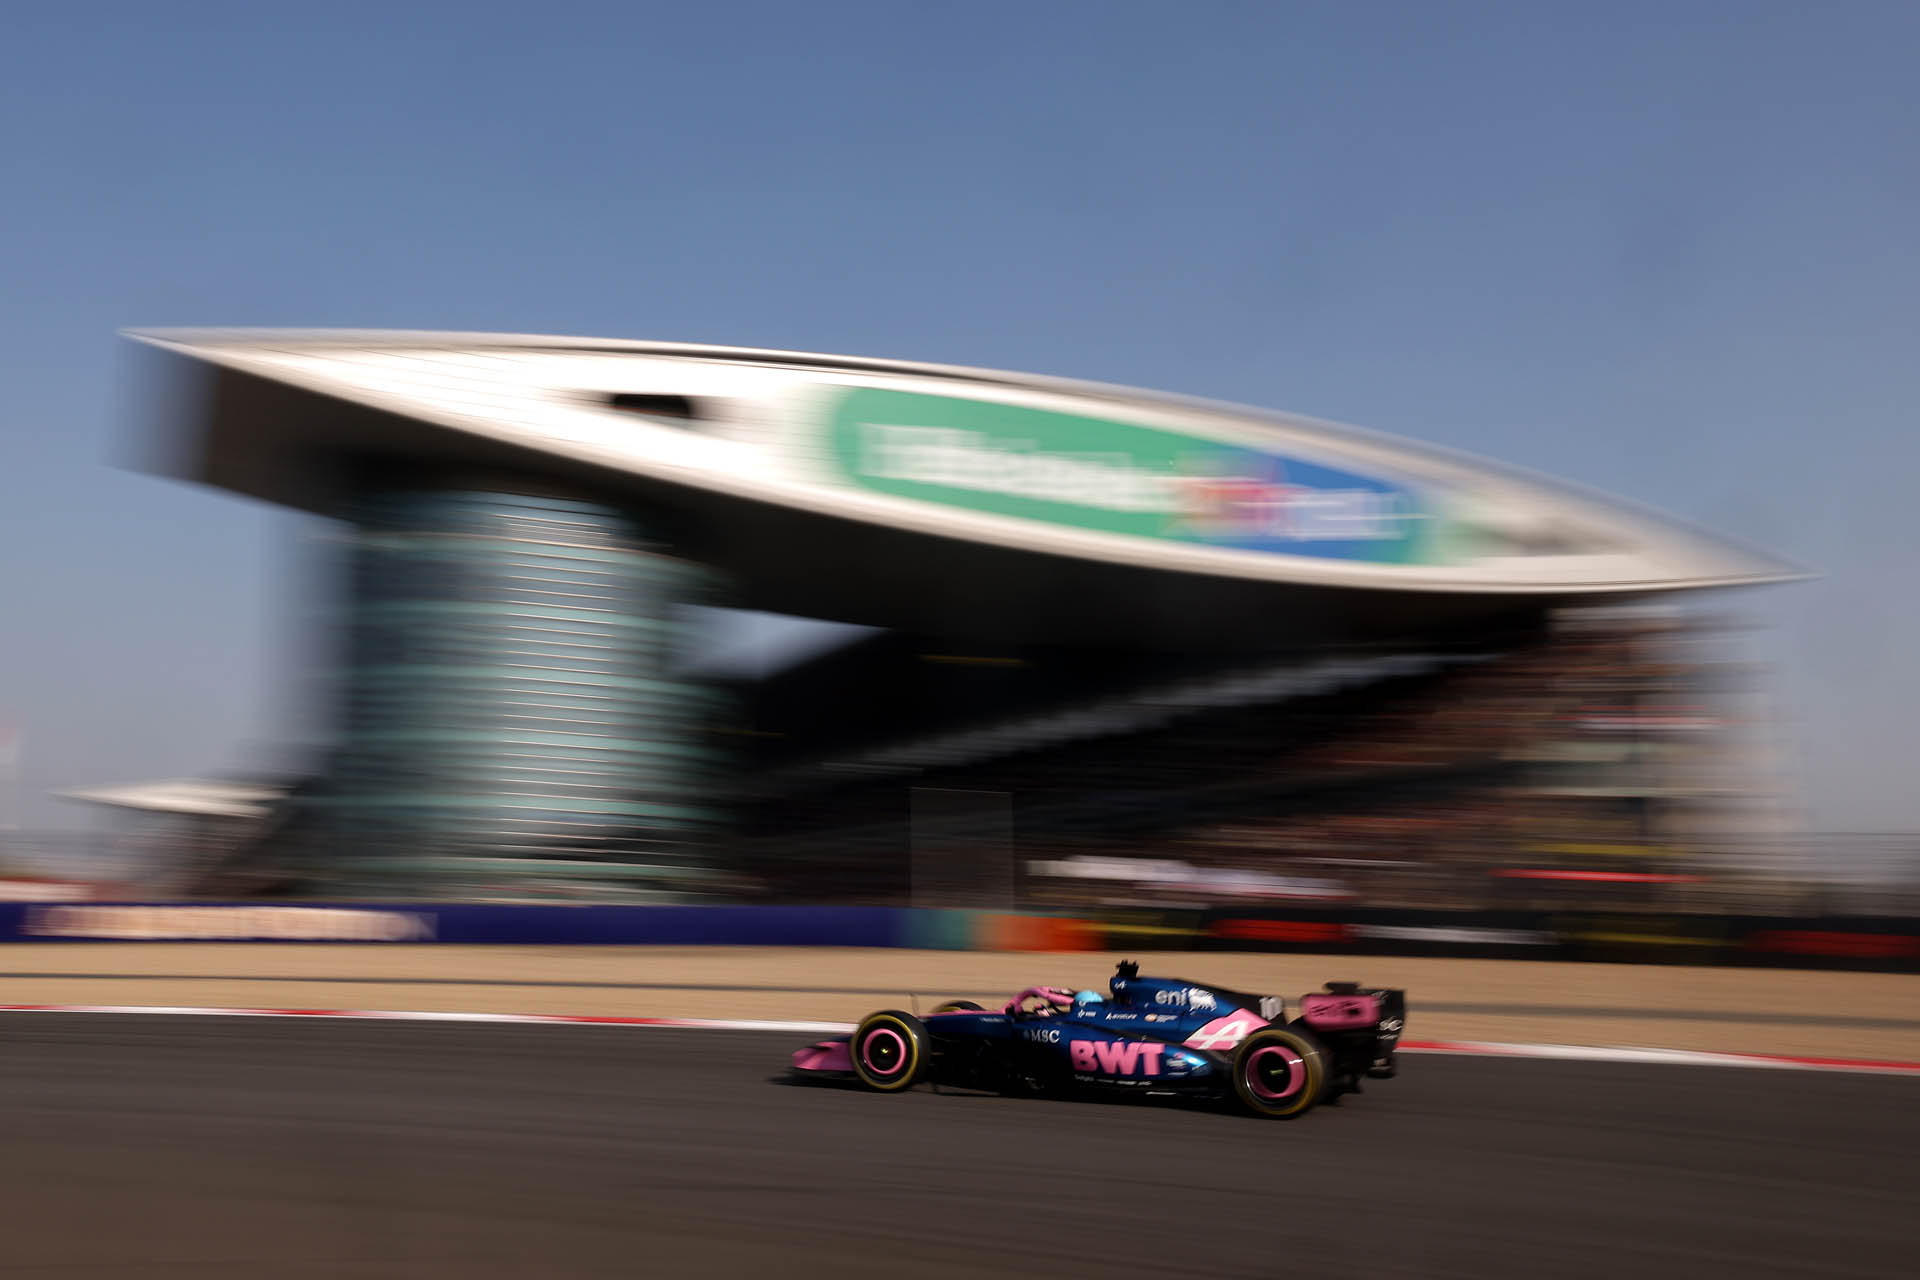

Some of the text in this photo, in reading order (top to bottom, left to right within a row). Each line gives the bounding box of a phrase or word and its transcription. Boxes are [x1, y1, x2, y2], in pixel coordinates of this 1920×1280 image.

[1155, 988, 1187, 1006] eni
[1031, 1029, 1060, 1044] MSC
[1070, 1039, 1166, 1076] BWT
